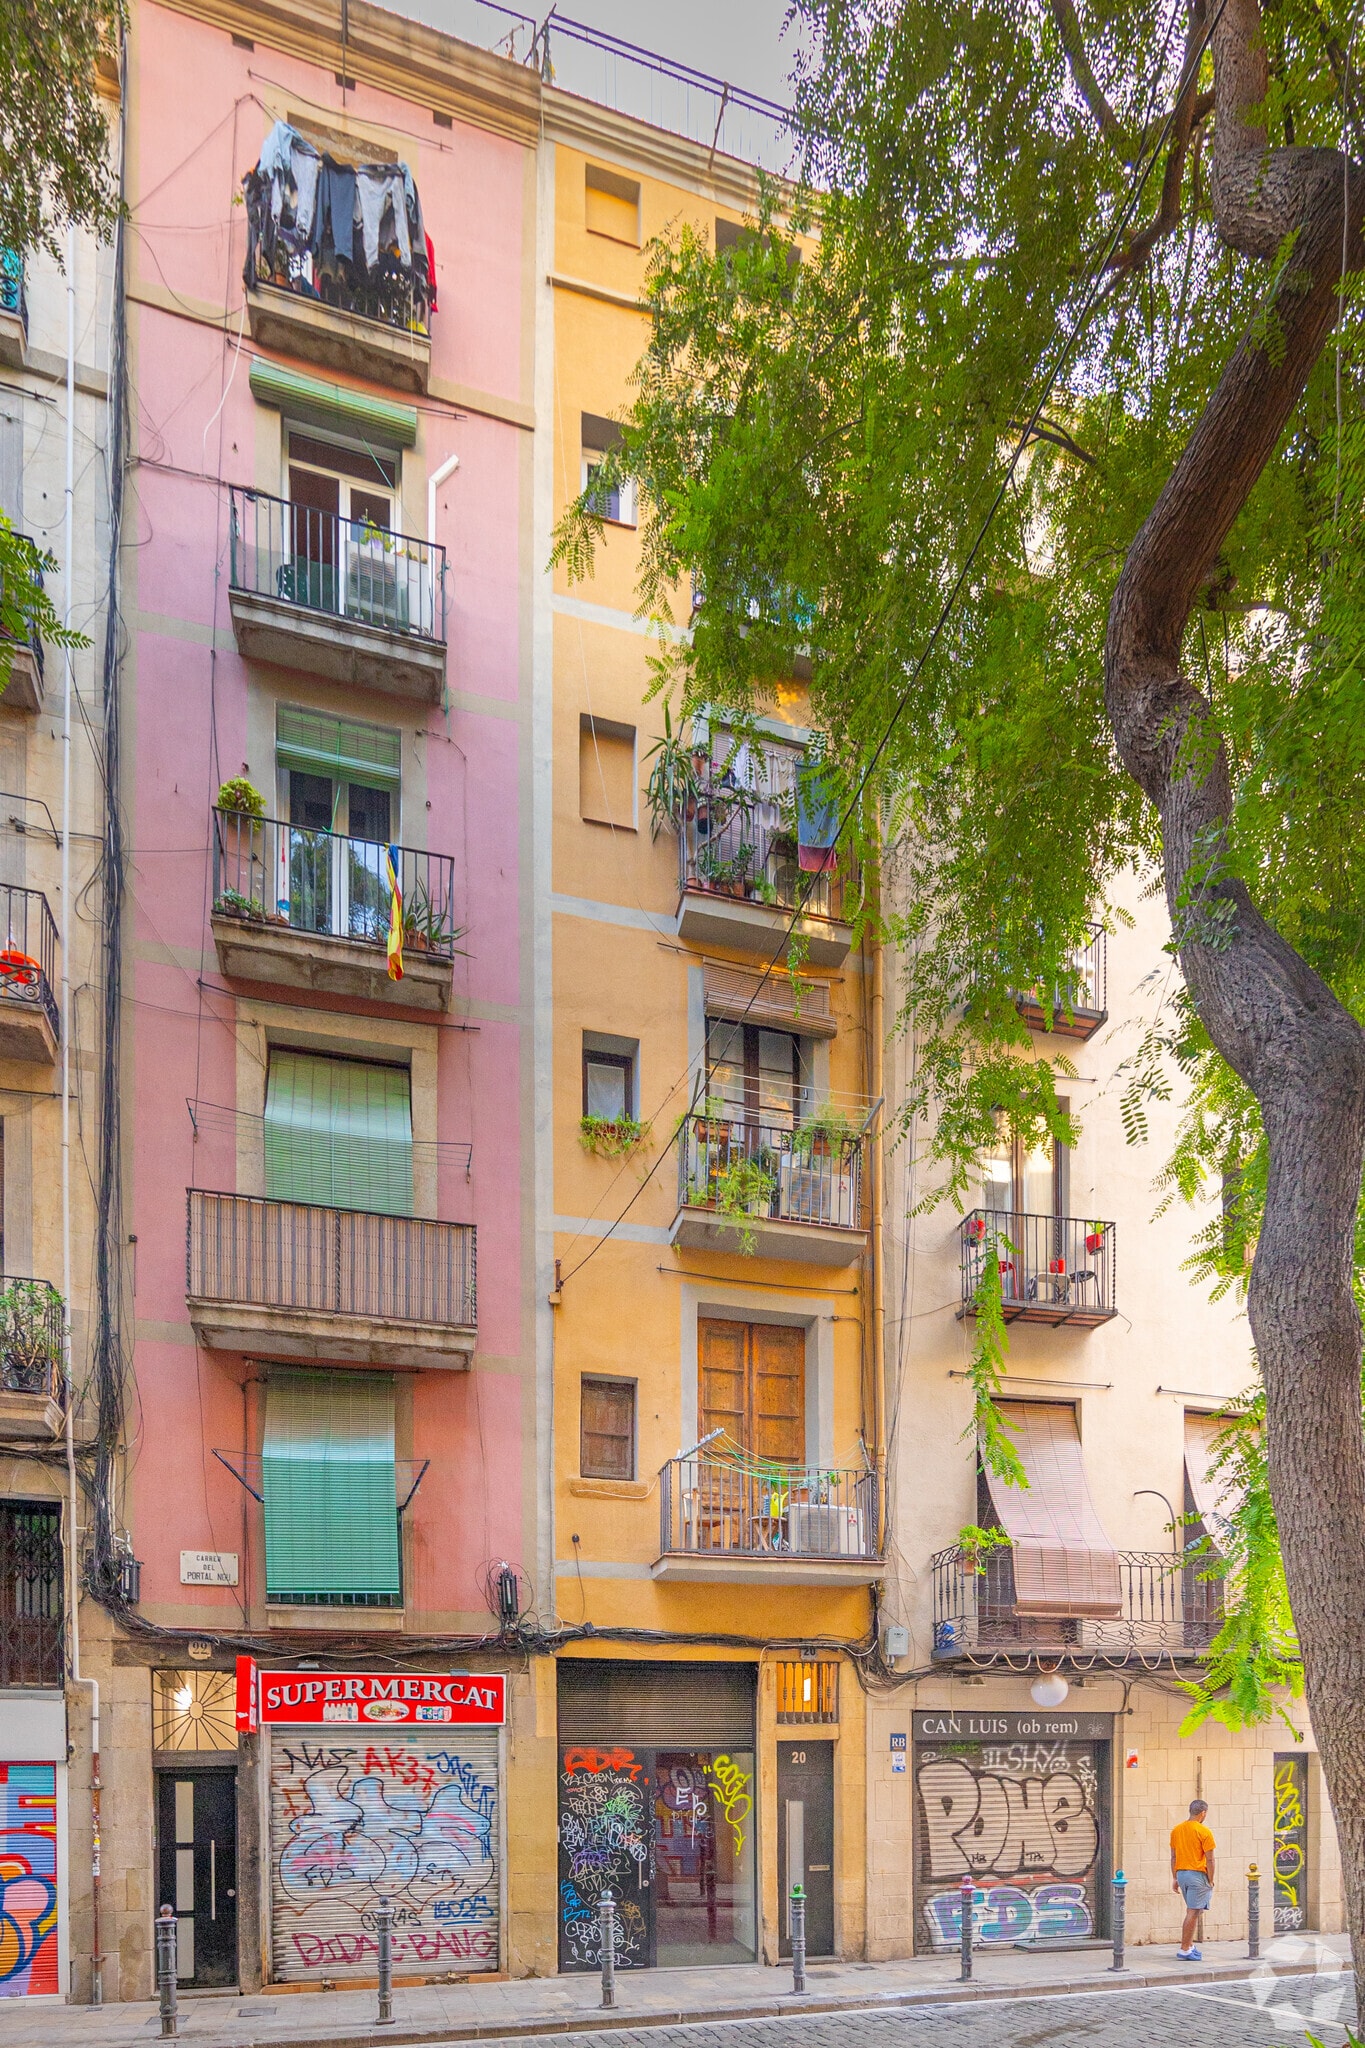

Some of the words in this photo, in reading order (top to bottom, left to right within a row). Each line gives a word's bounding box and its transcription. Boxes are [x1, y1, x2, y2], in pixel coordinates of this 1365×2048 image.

[196, 1554, 221, 1563] CARRER
[186, 1571, 213, 1581] PORTAL
[803, 1647, 816, 1657] 20
[266, 1677, 498, 1711] SUPERMERCAT
[922, 1718, 962, 1734] CAN
[968, 1718, 1008, 1734] LUIS
[1016, 1718, 1041, 1736] (ob
[1045, 1718, 1079, 1736] rem)
[891, 1737, 906, 1747] RB
[791, 1751, 807, 1764] 20
